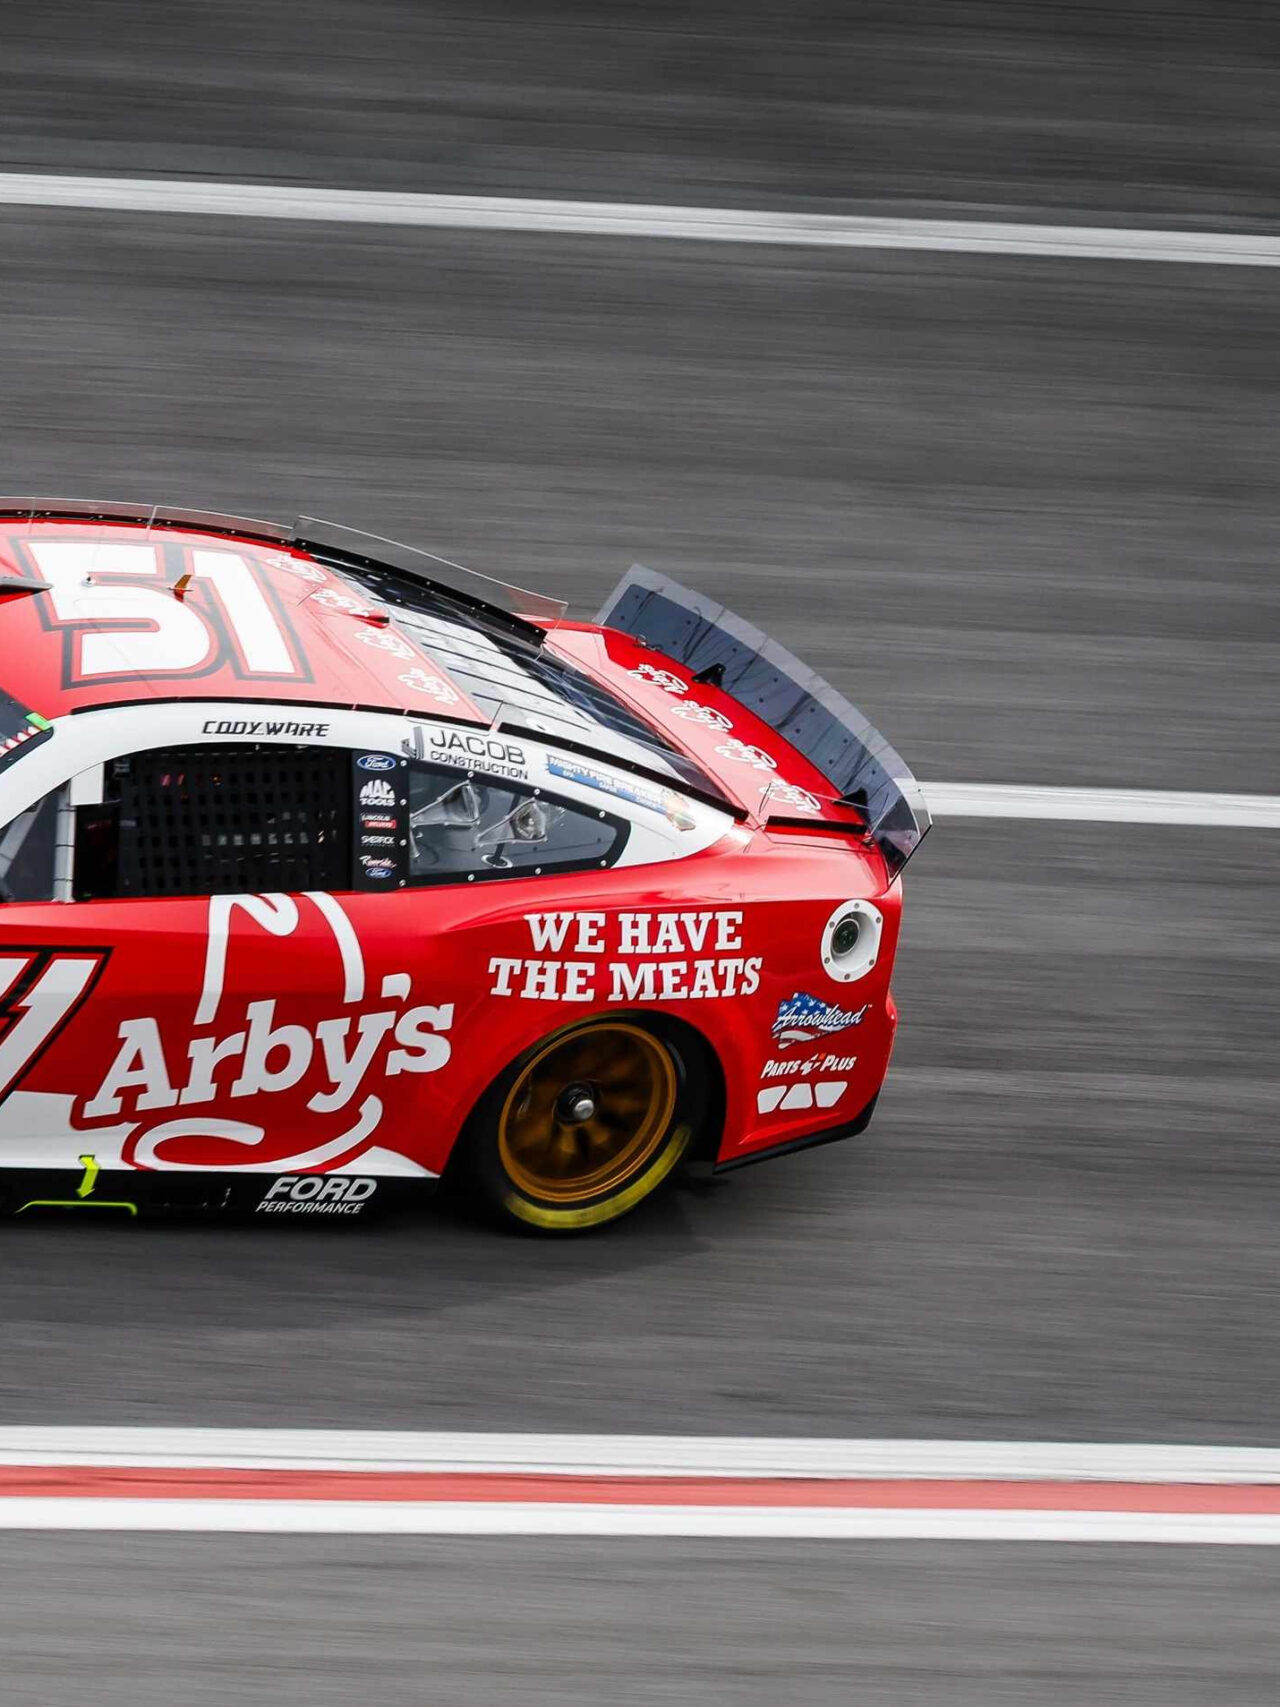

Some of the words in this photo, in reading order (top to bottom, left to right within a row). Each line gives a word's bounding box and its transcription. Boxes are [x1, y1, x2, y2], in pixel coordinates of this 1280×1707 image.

[22, 540, 302, 681] 51
[202, 721, 262, 735] CODY
[266, 721, 330, 737] WARE
[430, 730, 526, 765] JACOB
[430, 750, 528, 780] CONSTRUCTION
[359, 779, 396, 799] MAC
[359, 797, 396, 807] TOOLS
[523, 911, 606, 954] WE
[619, 911, 743, 955] HAVE
[488, 957, 595, 1002] THE
[609, 956, 763, 1002] MEATS
[771, 1003, 868, 1030] Arrowhead
[85, 973, 455, 1114] Arby's
[760, 1060, 802, 1079] PARTS
[820, 1054, 858, 1072] PLUS
[264, 1176, 378, 1202] FORD
[255, 1201, 365, 1214] PERFORMANCE
